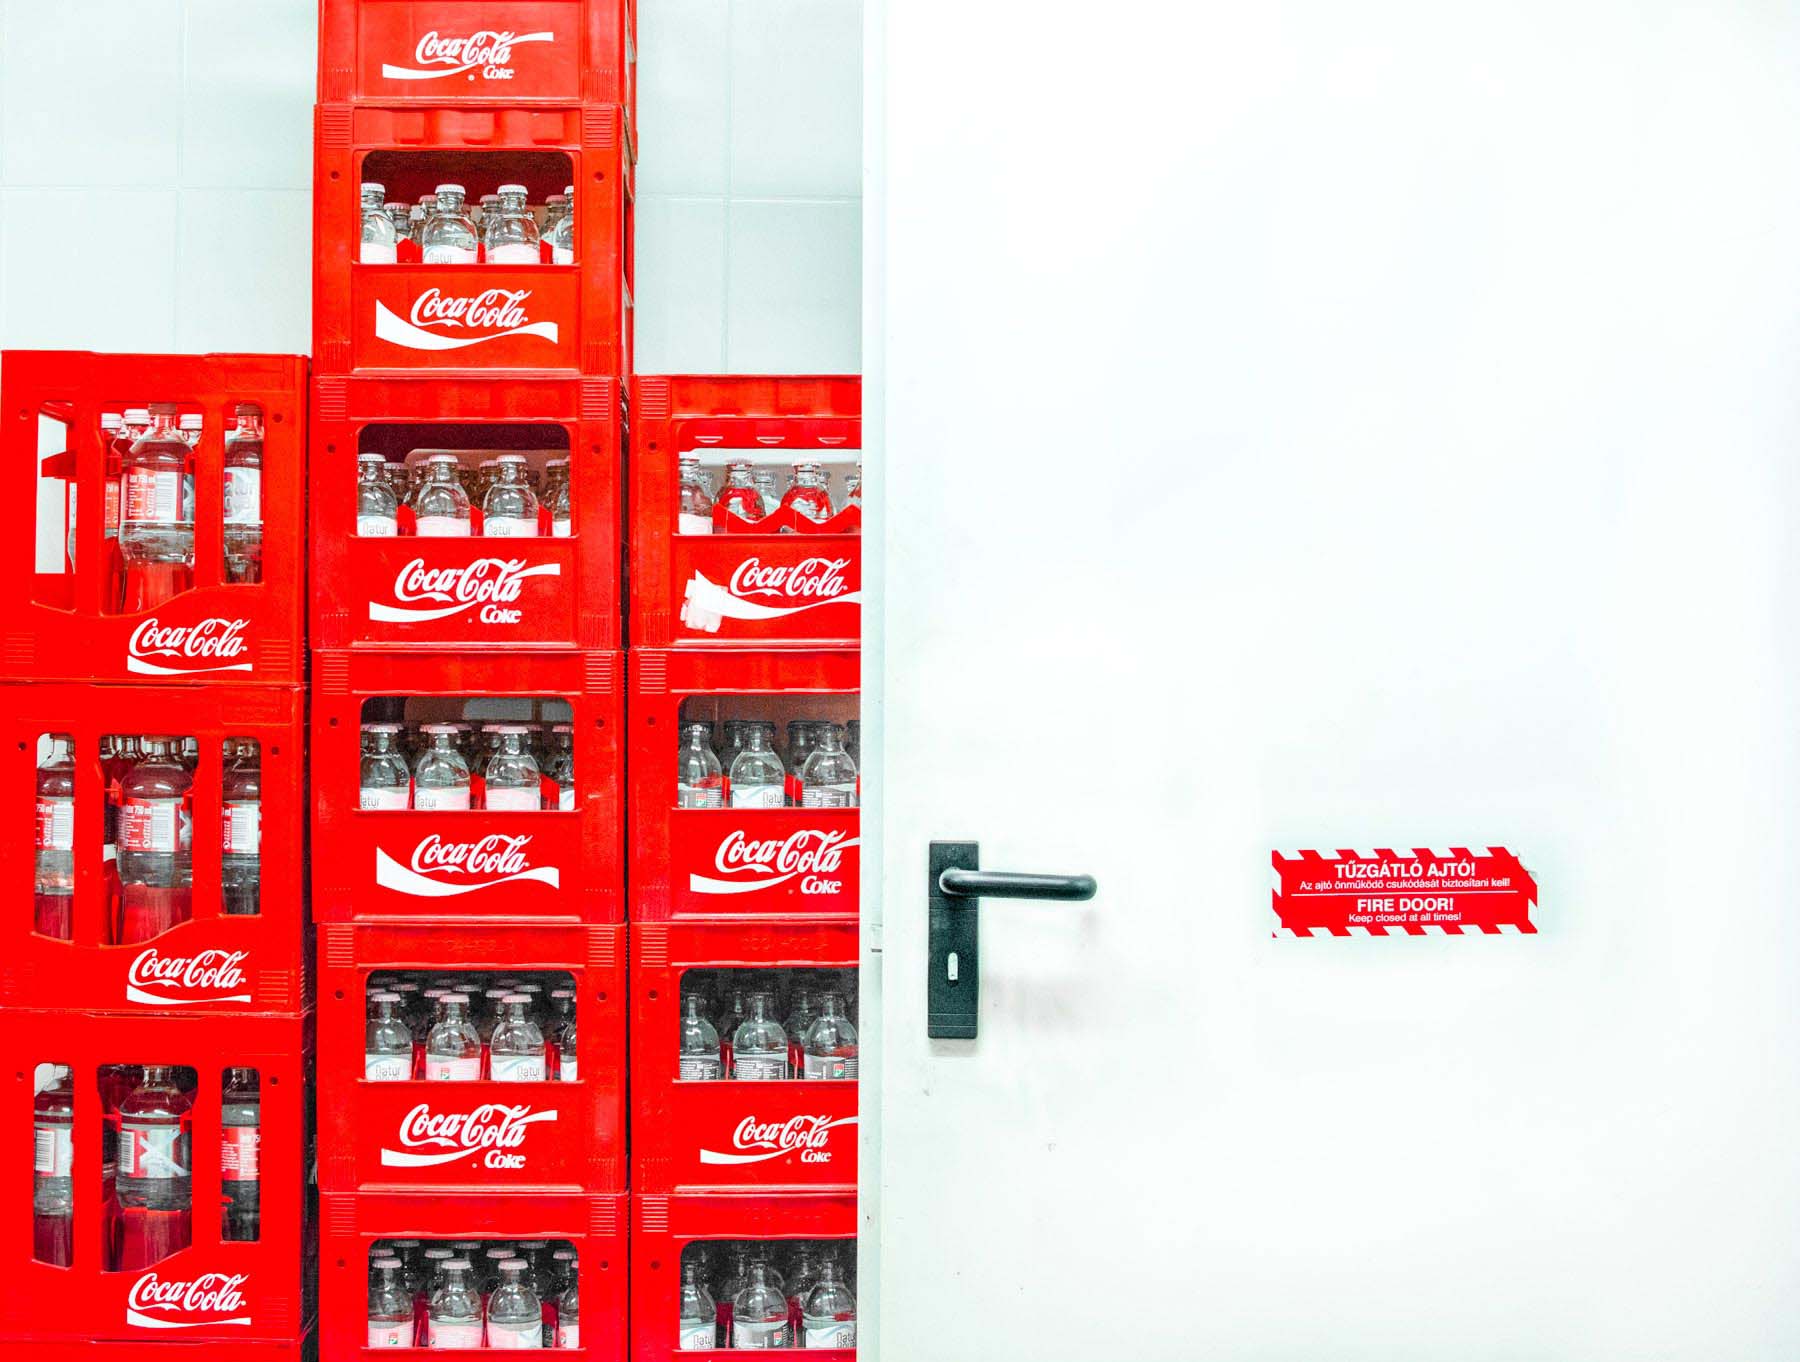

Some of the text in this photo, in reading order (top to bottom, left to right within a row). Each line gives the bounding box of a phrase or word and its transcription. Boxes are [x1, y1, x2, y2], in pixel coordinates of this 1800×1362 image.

[415, 31, 515, 65] Coca-Cola
[482, 65, 515, 80] Coke
[410, 287, 533, 328] Coca-Cola
[394, 558, 527, 602] Coca-Cola
[729, 557, 851, 597] Coca-Cola
[480, 604, 523, 624] Coke
[129, 618, 251, 657] Coca-Cola
[411, 834, 533, 874] Coca-Cola
[715, 829, 847, 873] Coca-Cola
[801, 875, 843, 894] Coke
[1299, 881, 1313, 890] Az
[1315, 880, 1332, 892] ajtó
[1386, 878, 1440, 889] csukódását
[1442, 877, 1489, 888] biztosítani
[1491, 877, 1511, 888] kell!
[1334, 858, 1476, 879] TŰZGÁTLÓ AJTÓ!
[1348, 911, 1462, 924] Keep closed at all times!
[1357, 897, 1455, 912] FIRE DOOR!
[128, 948, 250, 988] Coca-Cola
[399, 1103, 531, 1148] Coca-Cola
[733, 1115, 833, 1149] Coca-Cola
[484, 1149, 527, 1169] Coke
[801, 1148, 832, 1163] Coke
[128, 1272, 250, 1311] Coca-Cola
